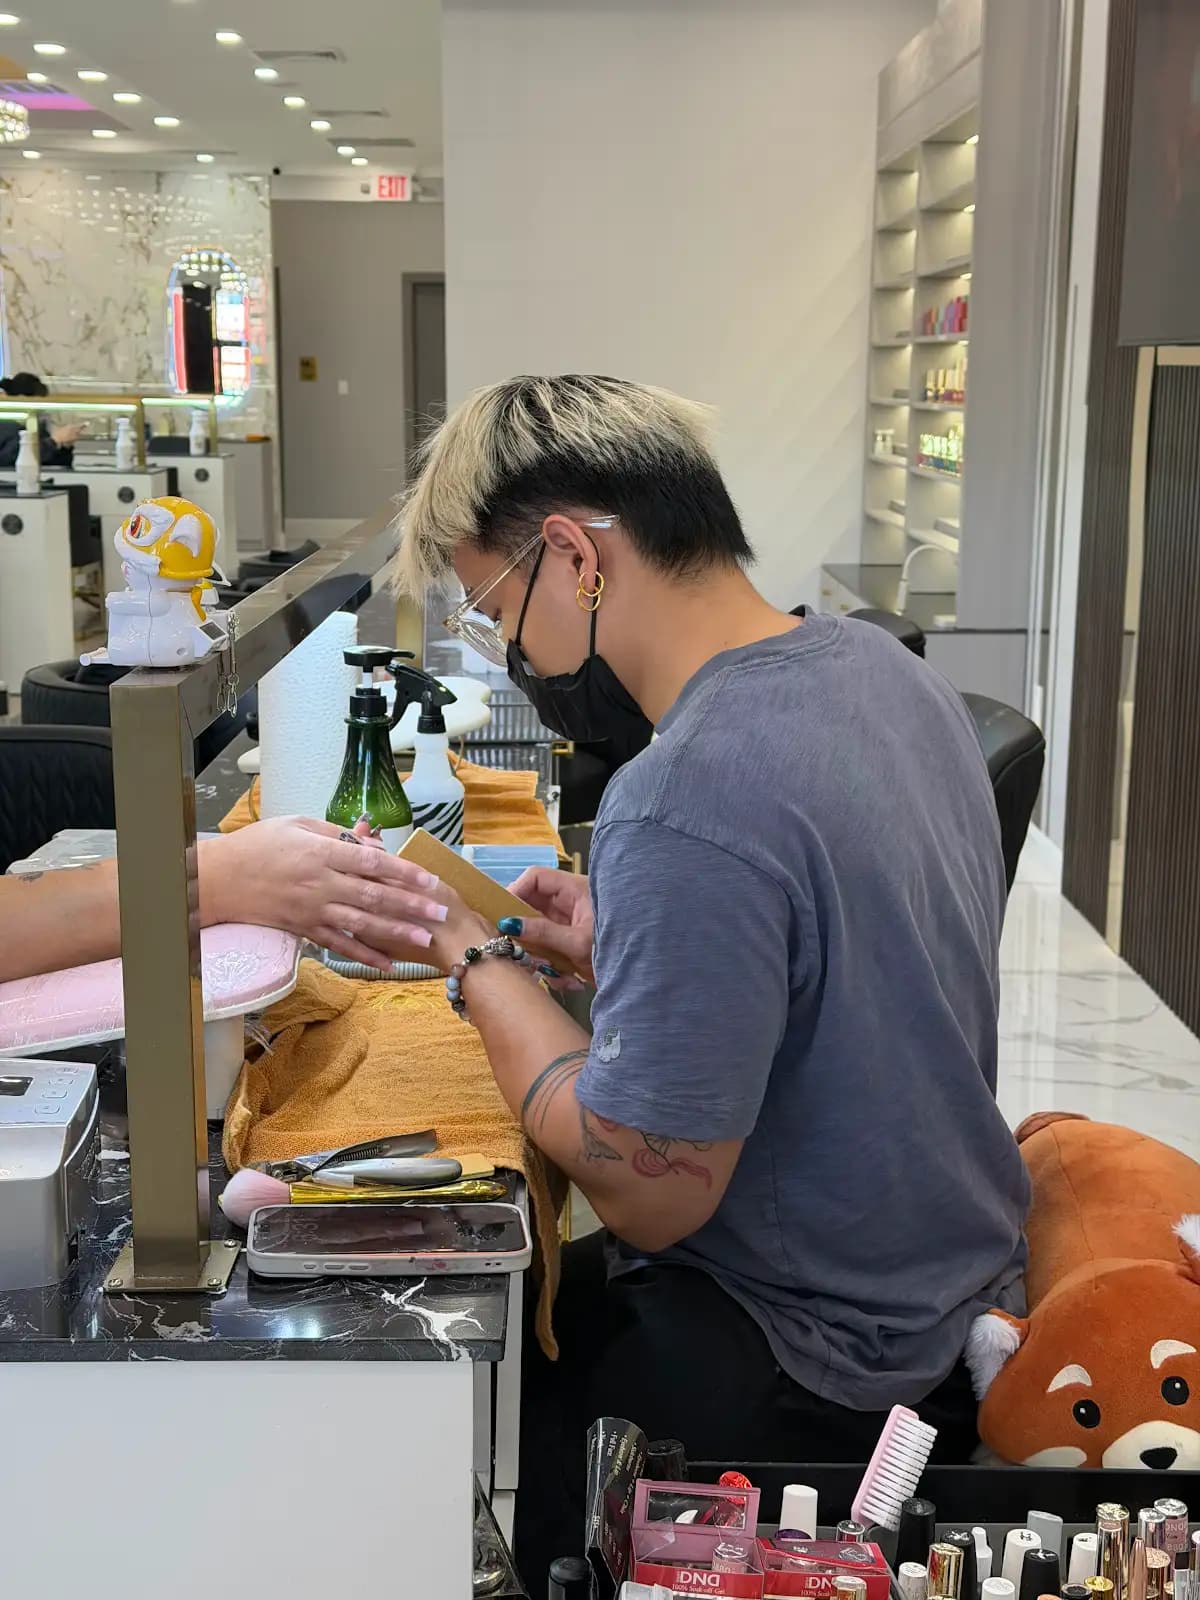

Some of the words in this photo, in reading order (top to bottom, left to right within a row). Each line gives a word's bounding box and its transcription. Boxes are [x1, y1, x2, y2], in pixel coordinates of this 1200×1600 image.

[378, 175, 407, 198] EXIT
[680, 1570, 720, 1588] DND
[810, 1576, 832, 1589] DN
[672, 1583, 688, 1592] 100%
